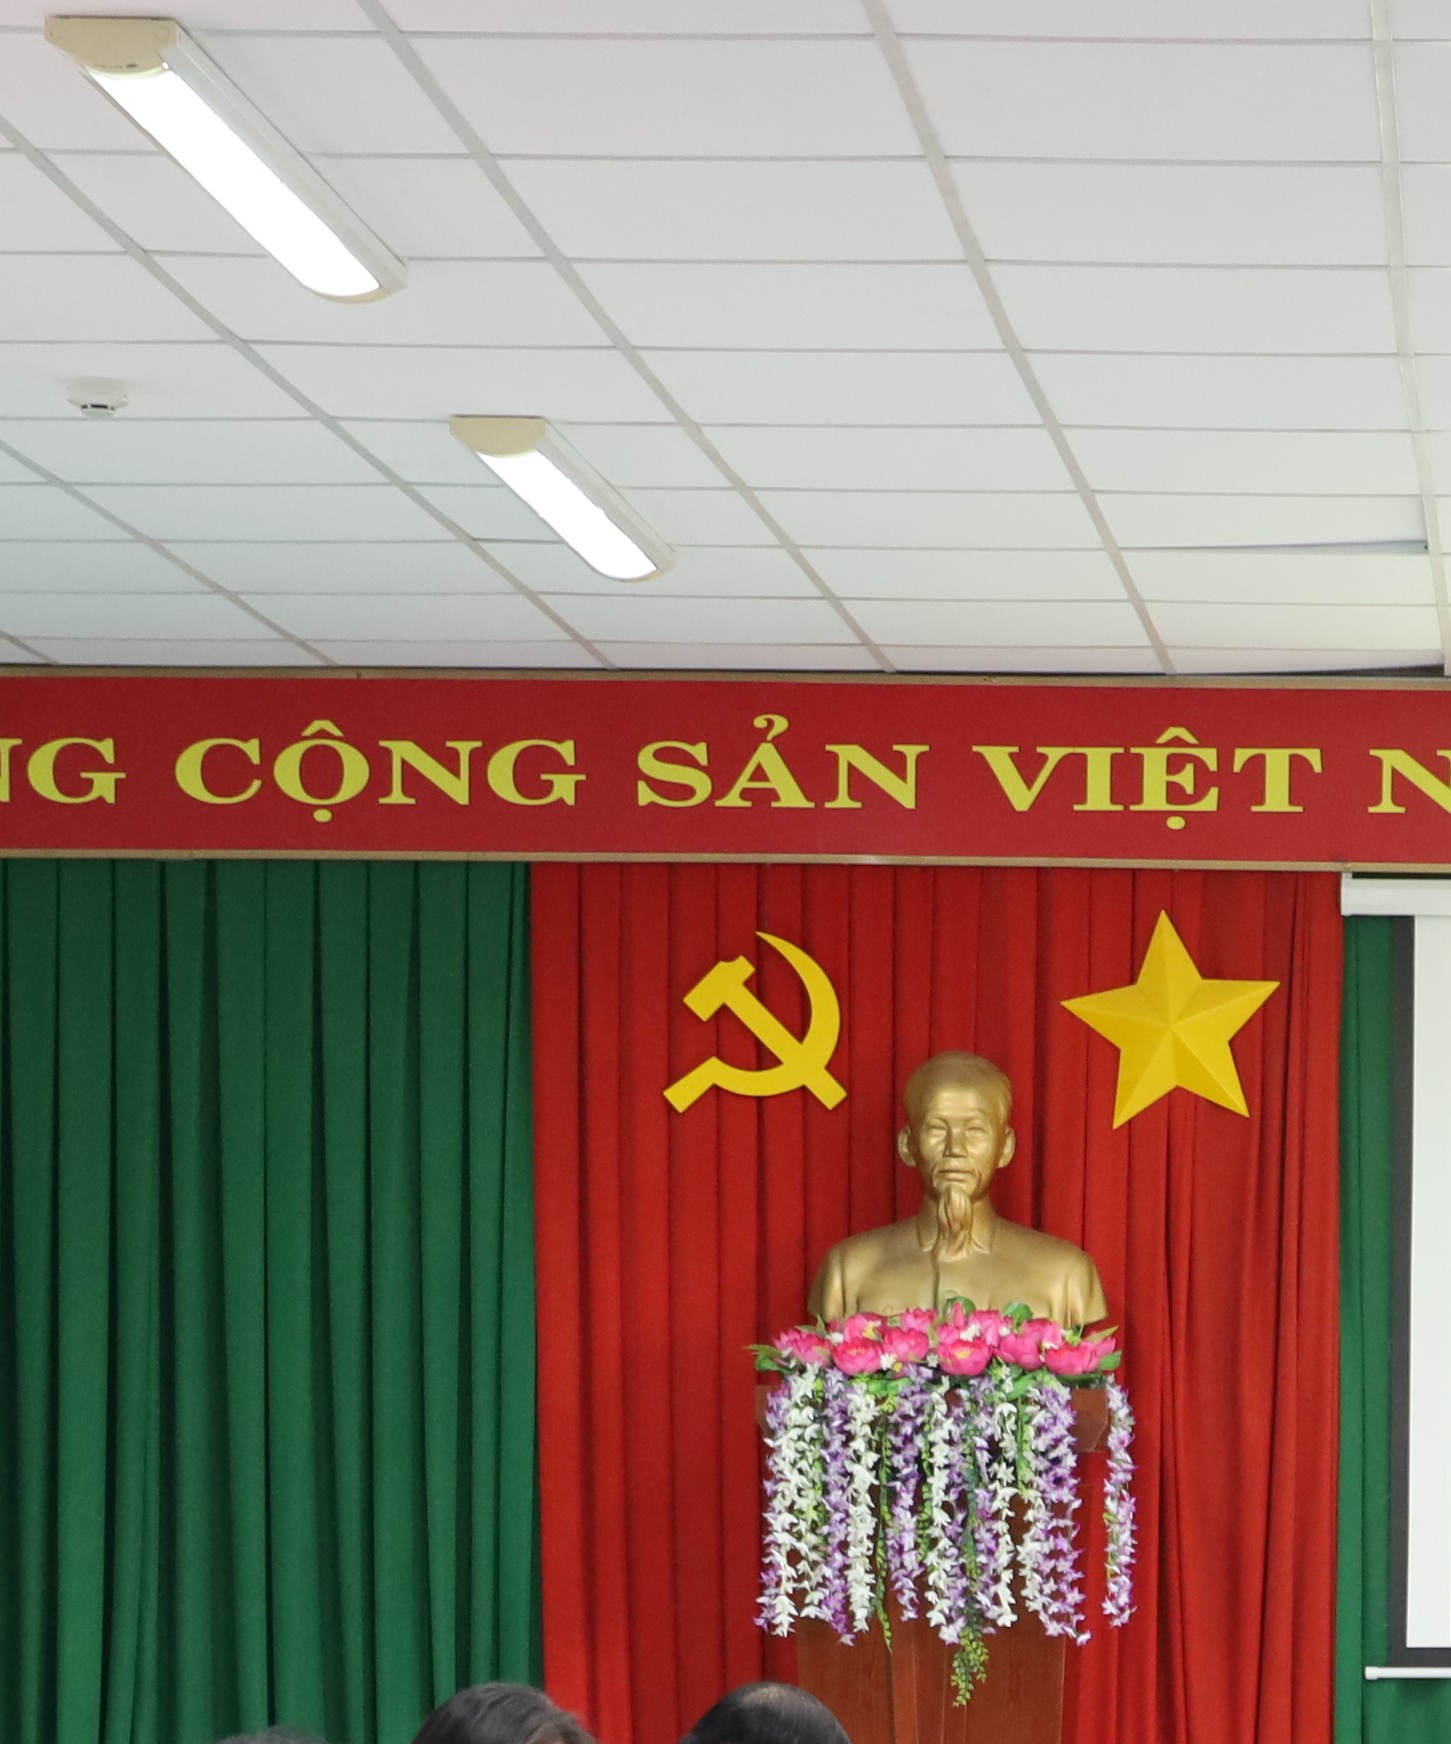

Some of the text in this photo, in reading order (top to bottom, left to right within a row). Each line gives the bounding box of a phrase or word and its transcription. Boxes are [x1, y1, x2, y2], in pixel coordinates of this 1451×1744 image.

[174, 719, 588, 824] CỘNG
[636, 714, 931, 810] SẢN
[971, 726, 1324, 831] VIỆT
